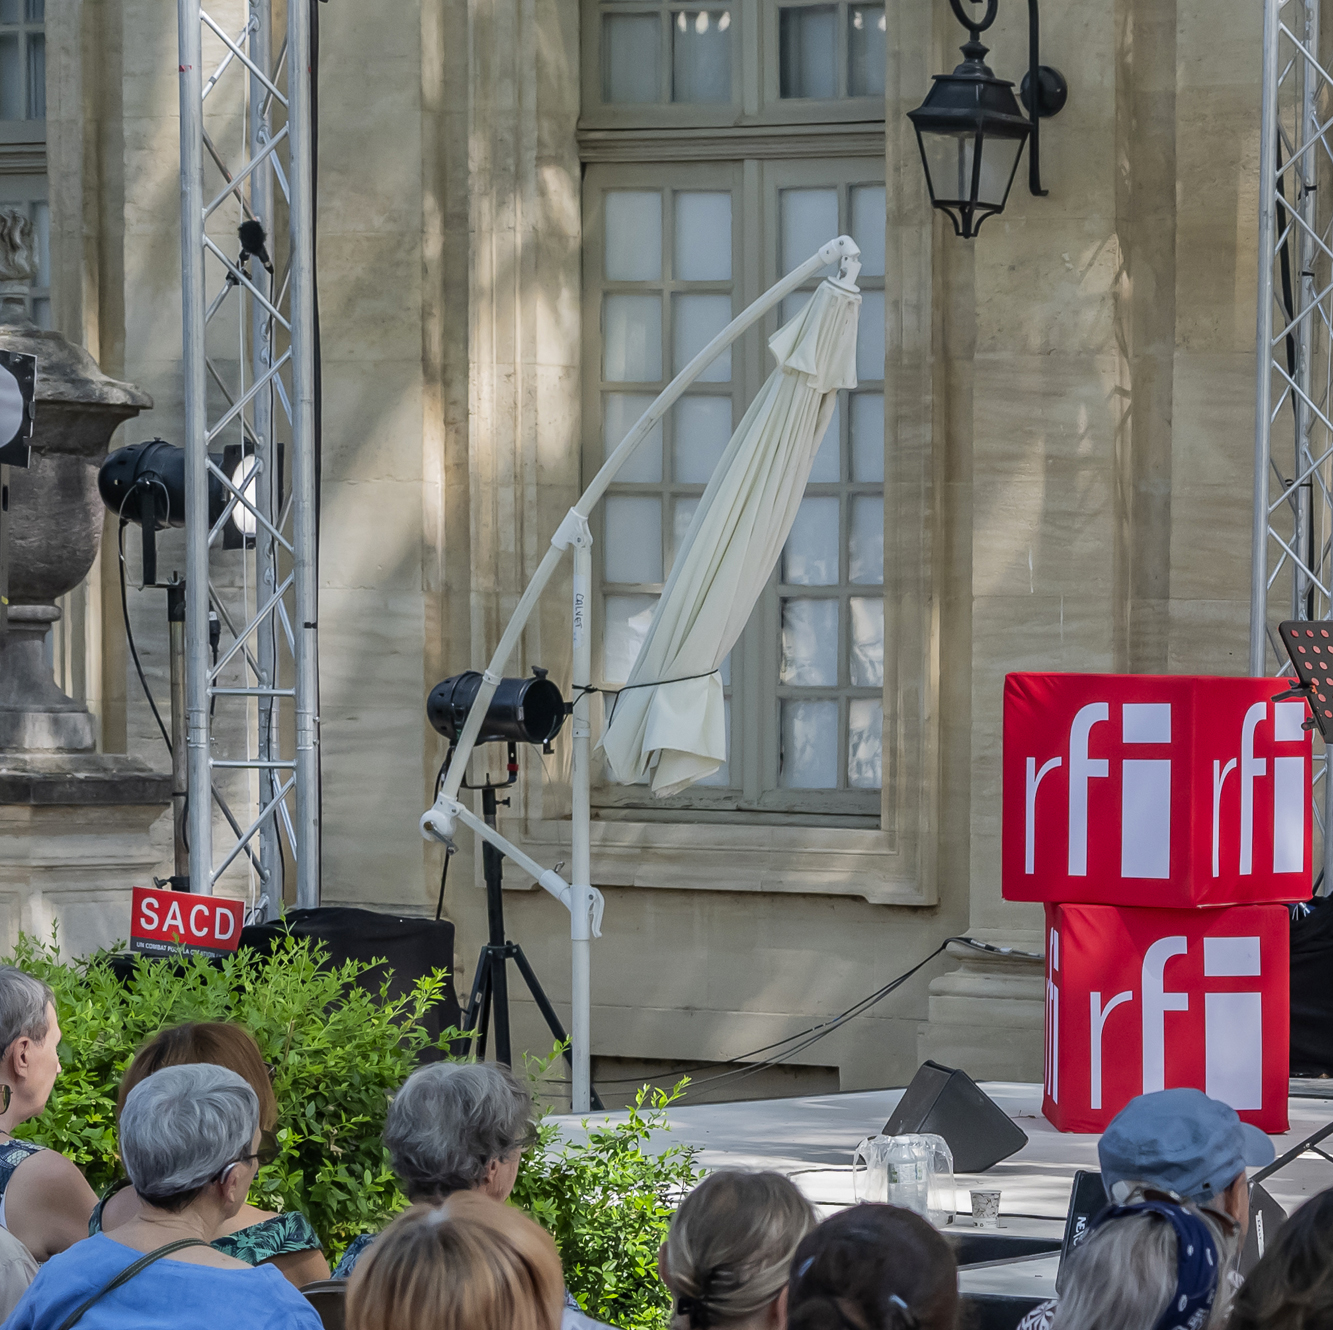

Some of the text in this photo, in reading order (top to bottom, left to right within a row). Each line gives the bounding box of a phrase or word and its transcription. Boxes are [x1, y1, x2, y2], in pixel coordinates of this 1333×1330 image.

[574, 593, 585, 629] CALVET
[1025, 702, 1172, 879] rfi
[1212, 702, 1305, 878] rfi
[140, 897, 235, 940] SACD
[145, 943, 167, 951] COMBAT
[1090, 936, 1263, 1110] rfi
